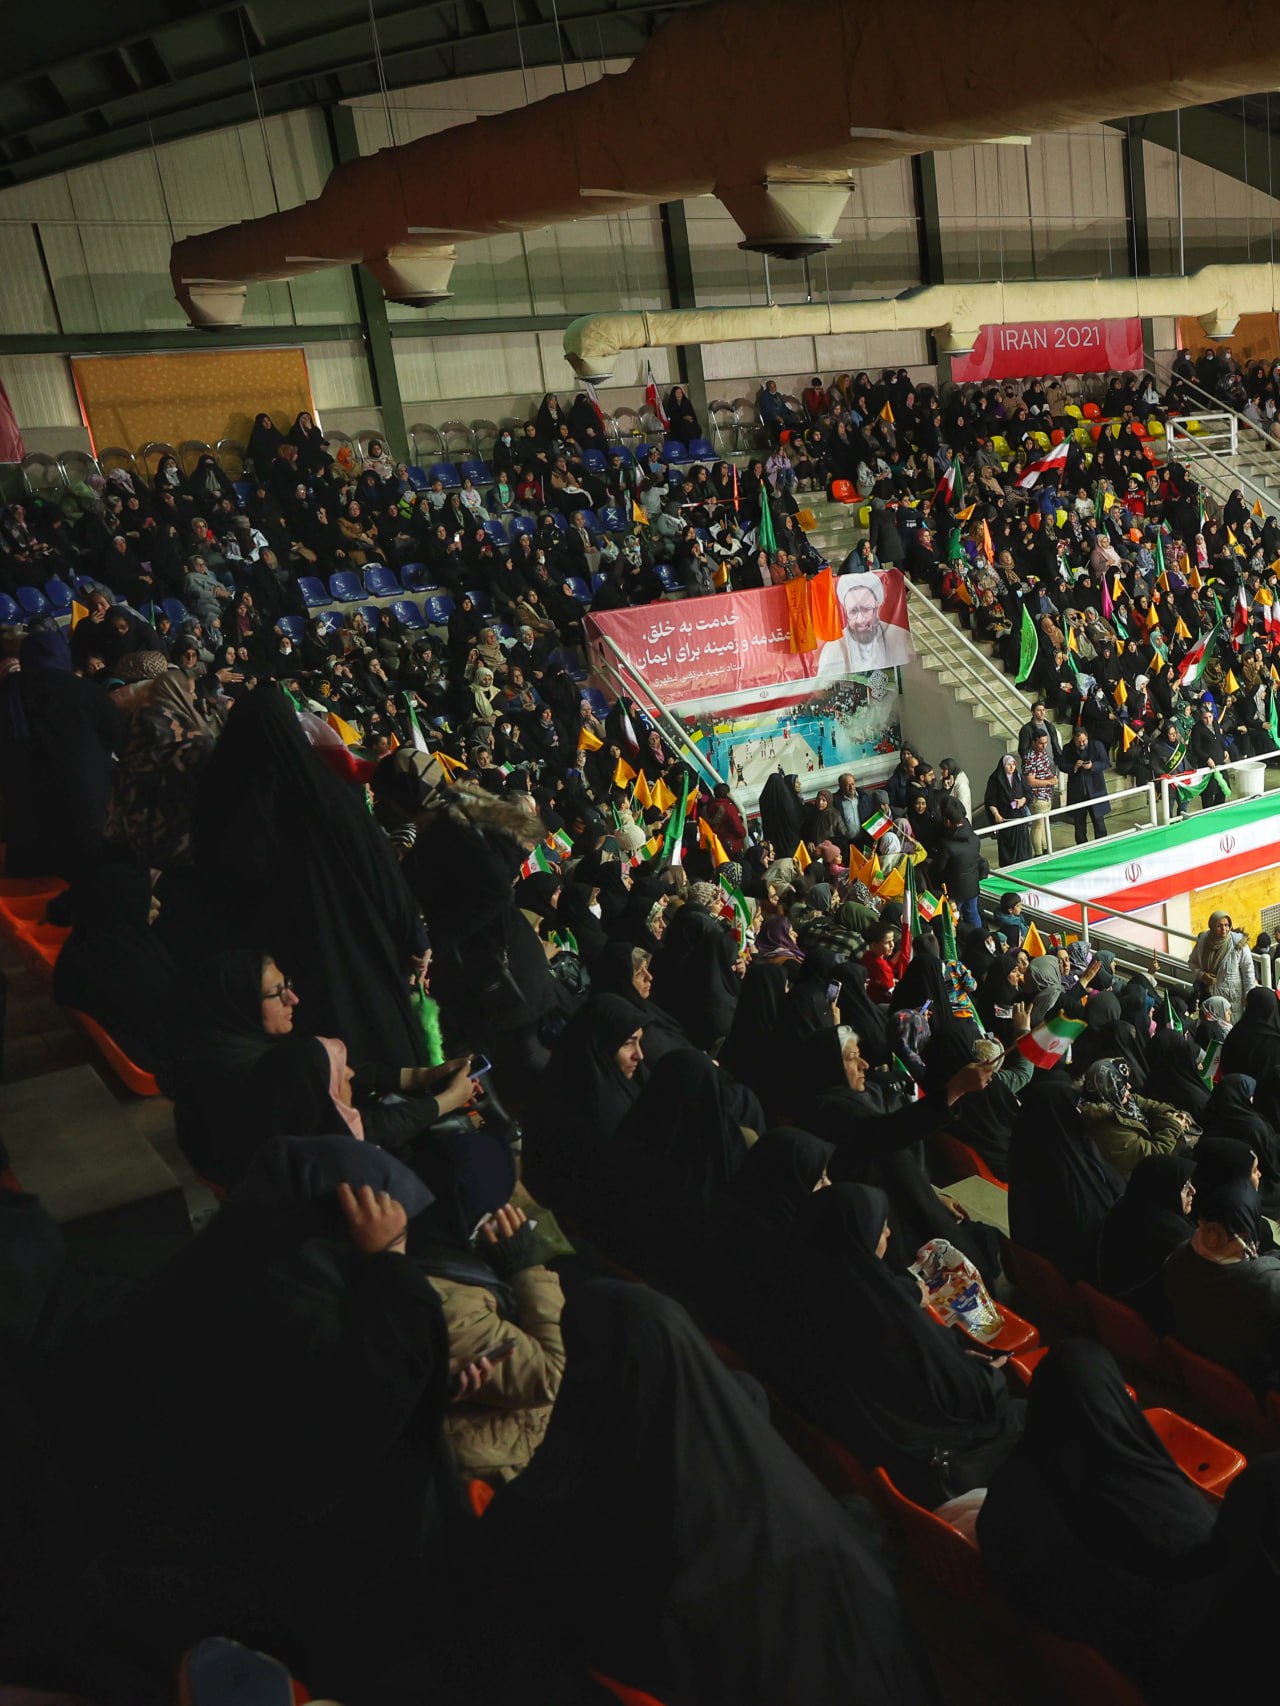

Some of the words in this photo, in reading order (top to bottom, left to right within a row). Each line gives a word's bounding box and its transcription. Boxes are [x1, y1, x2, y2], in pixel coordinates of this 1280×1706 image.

[1000, 328, 1048, 351] IRAN
[1054, 325, 1100, 348] 2021
[679, 620, 693, 637] به
[696, 609, 740, 630] خدمت
[704, 637, 739, 655] زمینه
[741, 638, 749, 653] و
[751, 628, 791, 646] مقدمه
[635, 646, 672, 670] ایمان
[675, 643, 701, 663] برای
[706, 667, 726, 677] شهید
